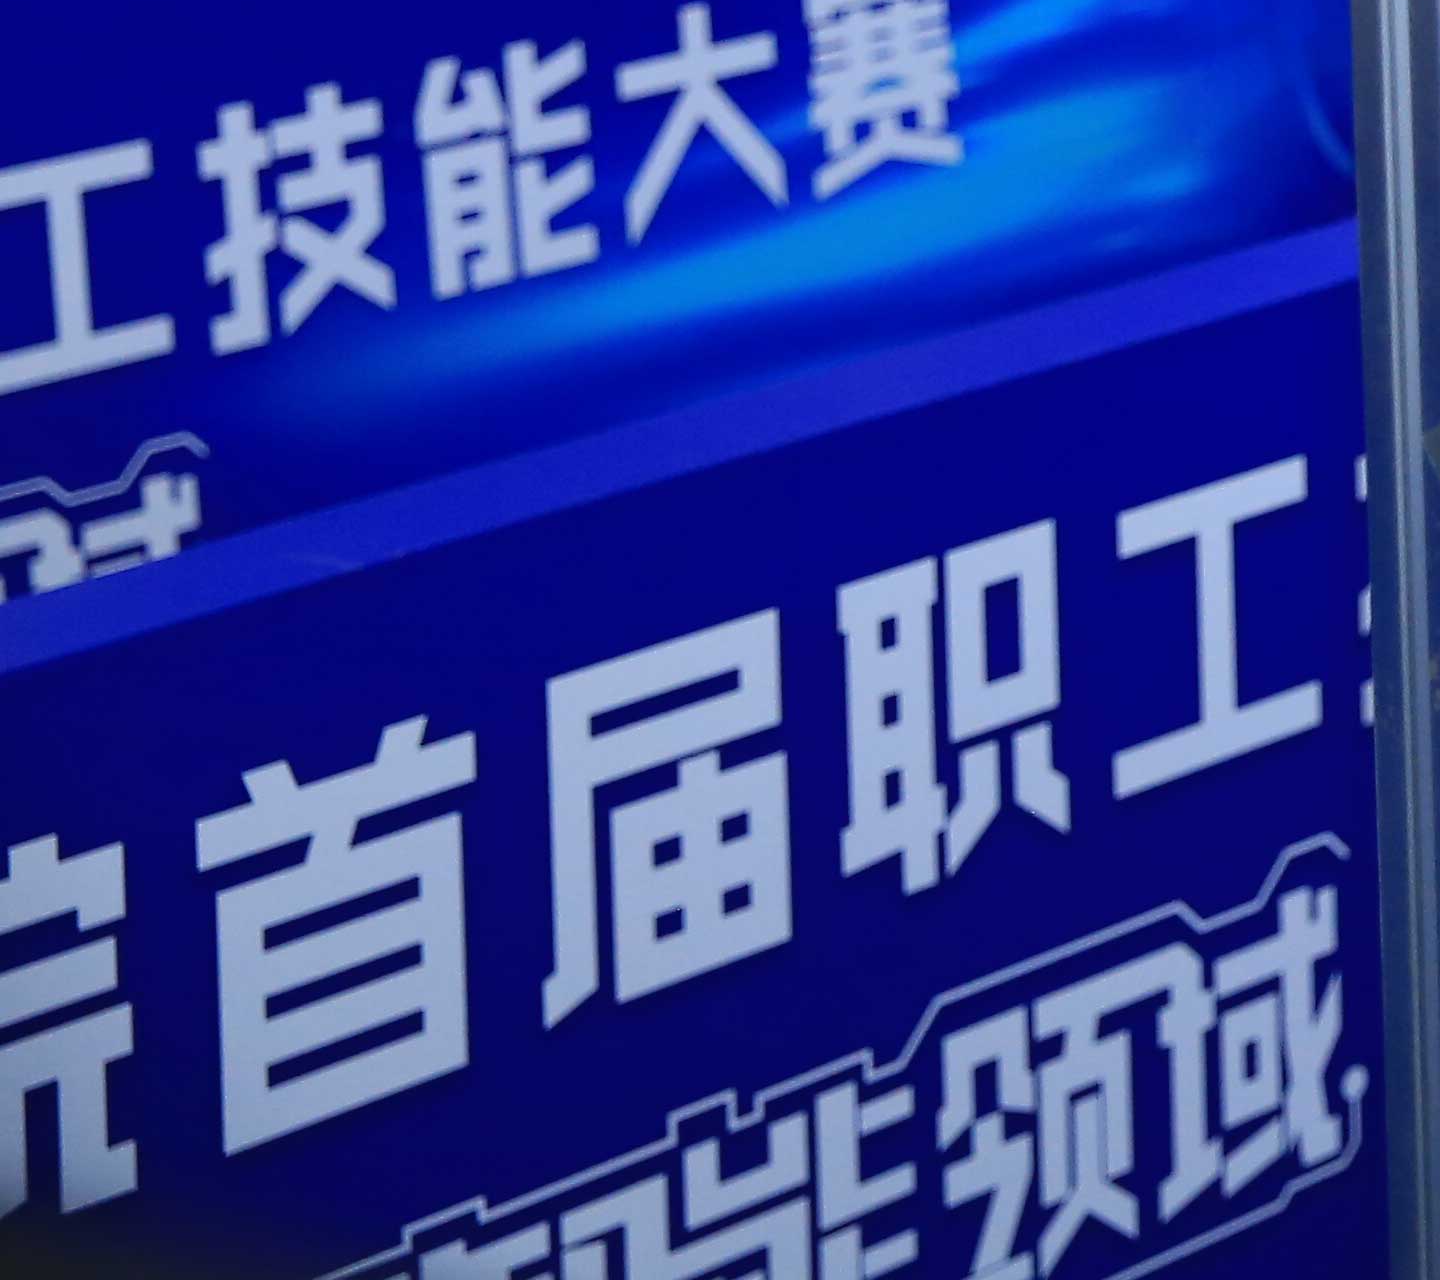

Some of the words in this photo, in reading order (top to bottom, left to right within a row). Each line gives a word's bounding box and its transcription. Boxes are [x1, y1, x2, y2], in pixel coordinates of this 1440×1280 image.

[0, 453, 1375, 1218] 院首届职工
